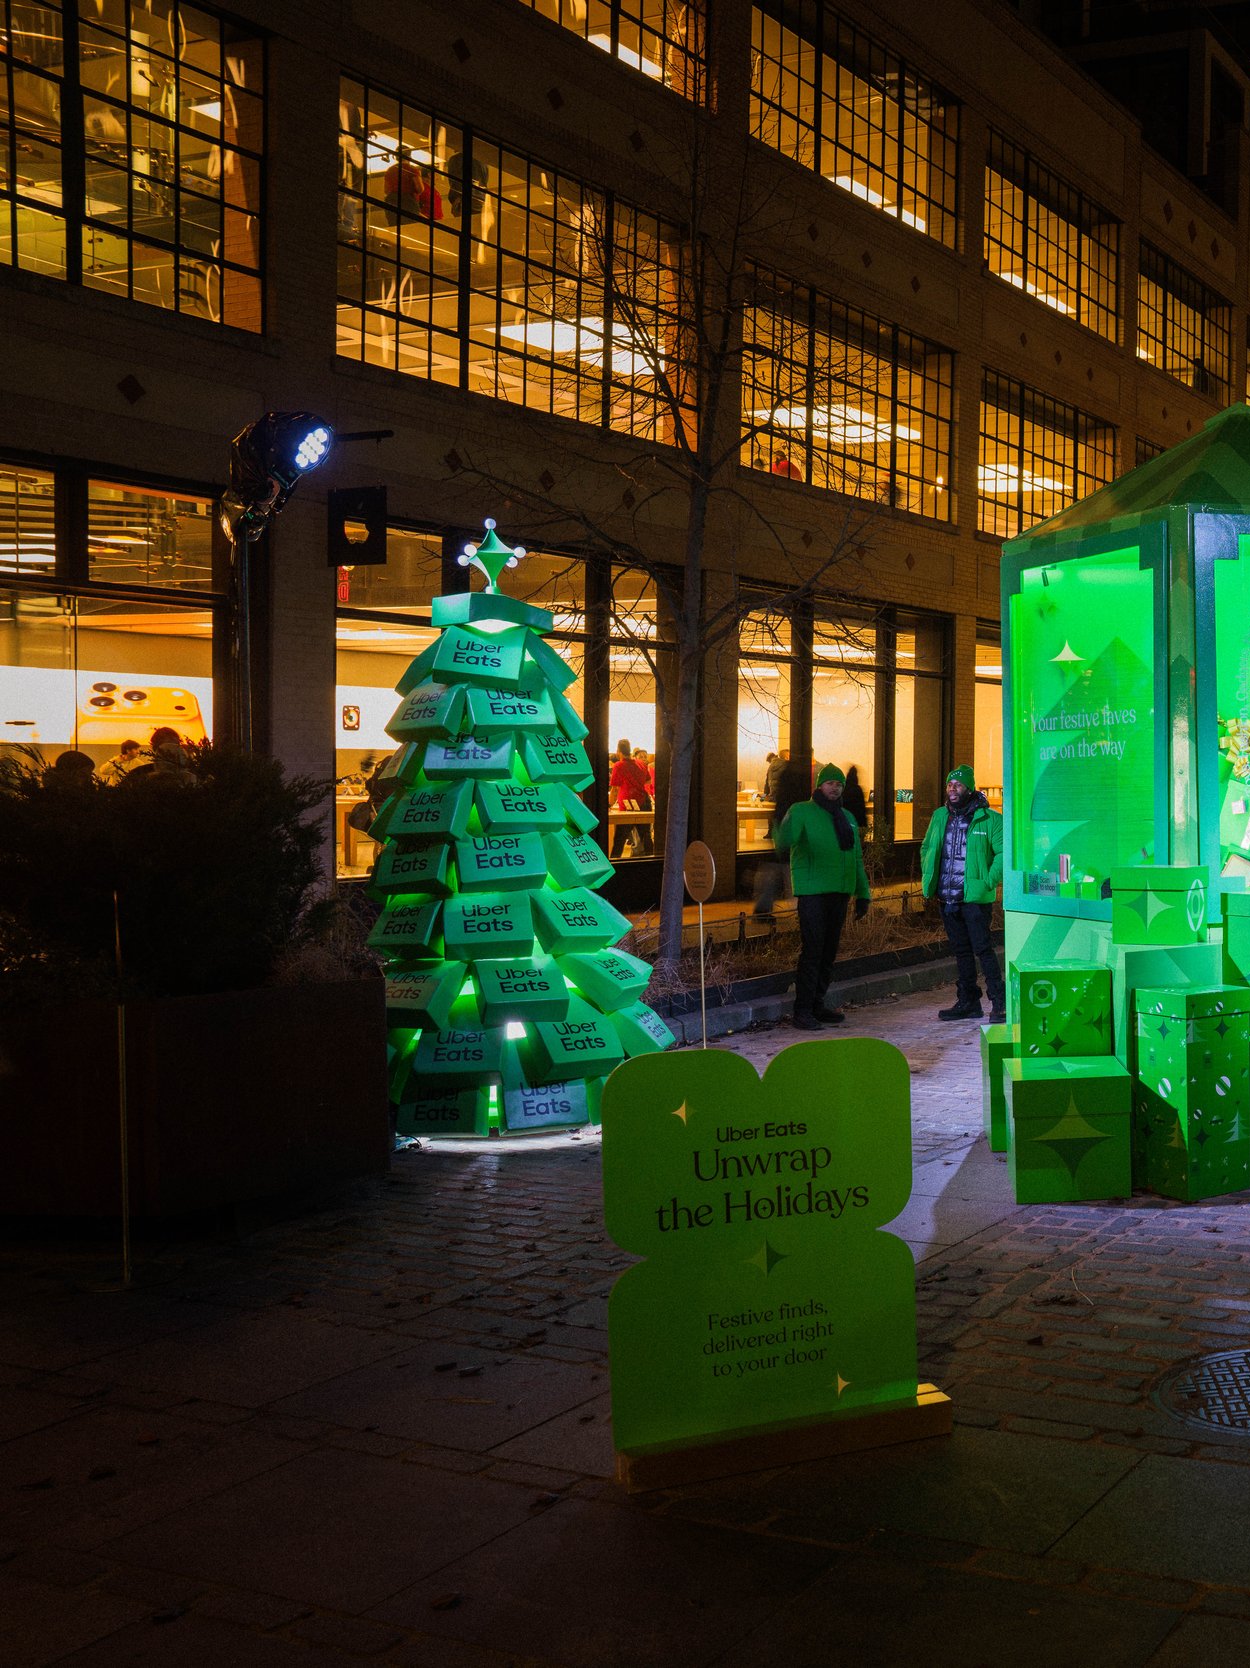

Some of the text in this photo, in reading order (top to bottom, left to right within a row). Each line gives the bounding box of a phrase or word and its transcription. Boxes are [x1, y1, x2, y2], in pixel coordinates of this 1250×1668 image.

[455, 639, 504, 653] Uber
[452, 651, 502, 668] Eats
[410, 691, 445, 705] Uber
[485, 688, 533, 701] Uber
[401, 705, 438, 721] Eats
[489, 702, 539, 715] Eats
[1030, 704, 1137, 733] Your festive faves
[443, 747, 492, 761] Eats
[1040, 737, 1126, 760] are on the way
[546, 750, 578, 765] Eats
[495, 784, 540, 797] Uber
[410, 791, 446, 806] Uber
[501, 798, 547, 813] Eats
[402, 808, 441, 823] Eats
[473, 836, 521, 851] Uber
[475, 853, 526, 870] Eats
[574, 849, 599, 864] Eats
[391, 858, 428, 874] Eats
[391, 904, 424, 918] Uber
[462, 903, 511, 918] Uber
[552, 899, 589, 912] Uber
[463, 918, 514, 934] Eats
[562, 913, 599, 927] Eats
[382, 921, 418, 935] Eats
[391, 972, 433, 984] Uber
[495, 968, 544, 981] Uber
[499, 979, 551, 993] Eats
[553, 1021, 598, 1036] Uber
[436, 1030, 486, 1045] Uber
[560, 1036, 607, 1052] Eats
[432, 1047, 484, 1063] Eats
[519, 1080, 568, 1097] Uber
[414, 1104, 460, 1121] Eats
[522, 1098, 572, 1117] Eats
[716, 1121, 808, 1143] Uber Eats
[692, 1146, 832, 1182] Unwrap
[655, 1181, 870, 1232] the Holidays
[708, 1299, 828, 1331] Festive finds,
[702, 1321, 835, 1356] delivered right
[713, 1347, 828, 1378] to your door
